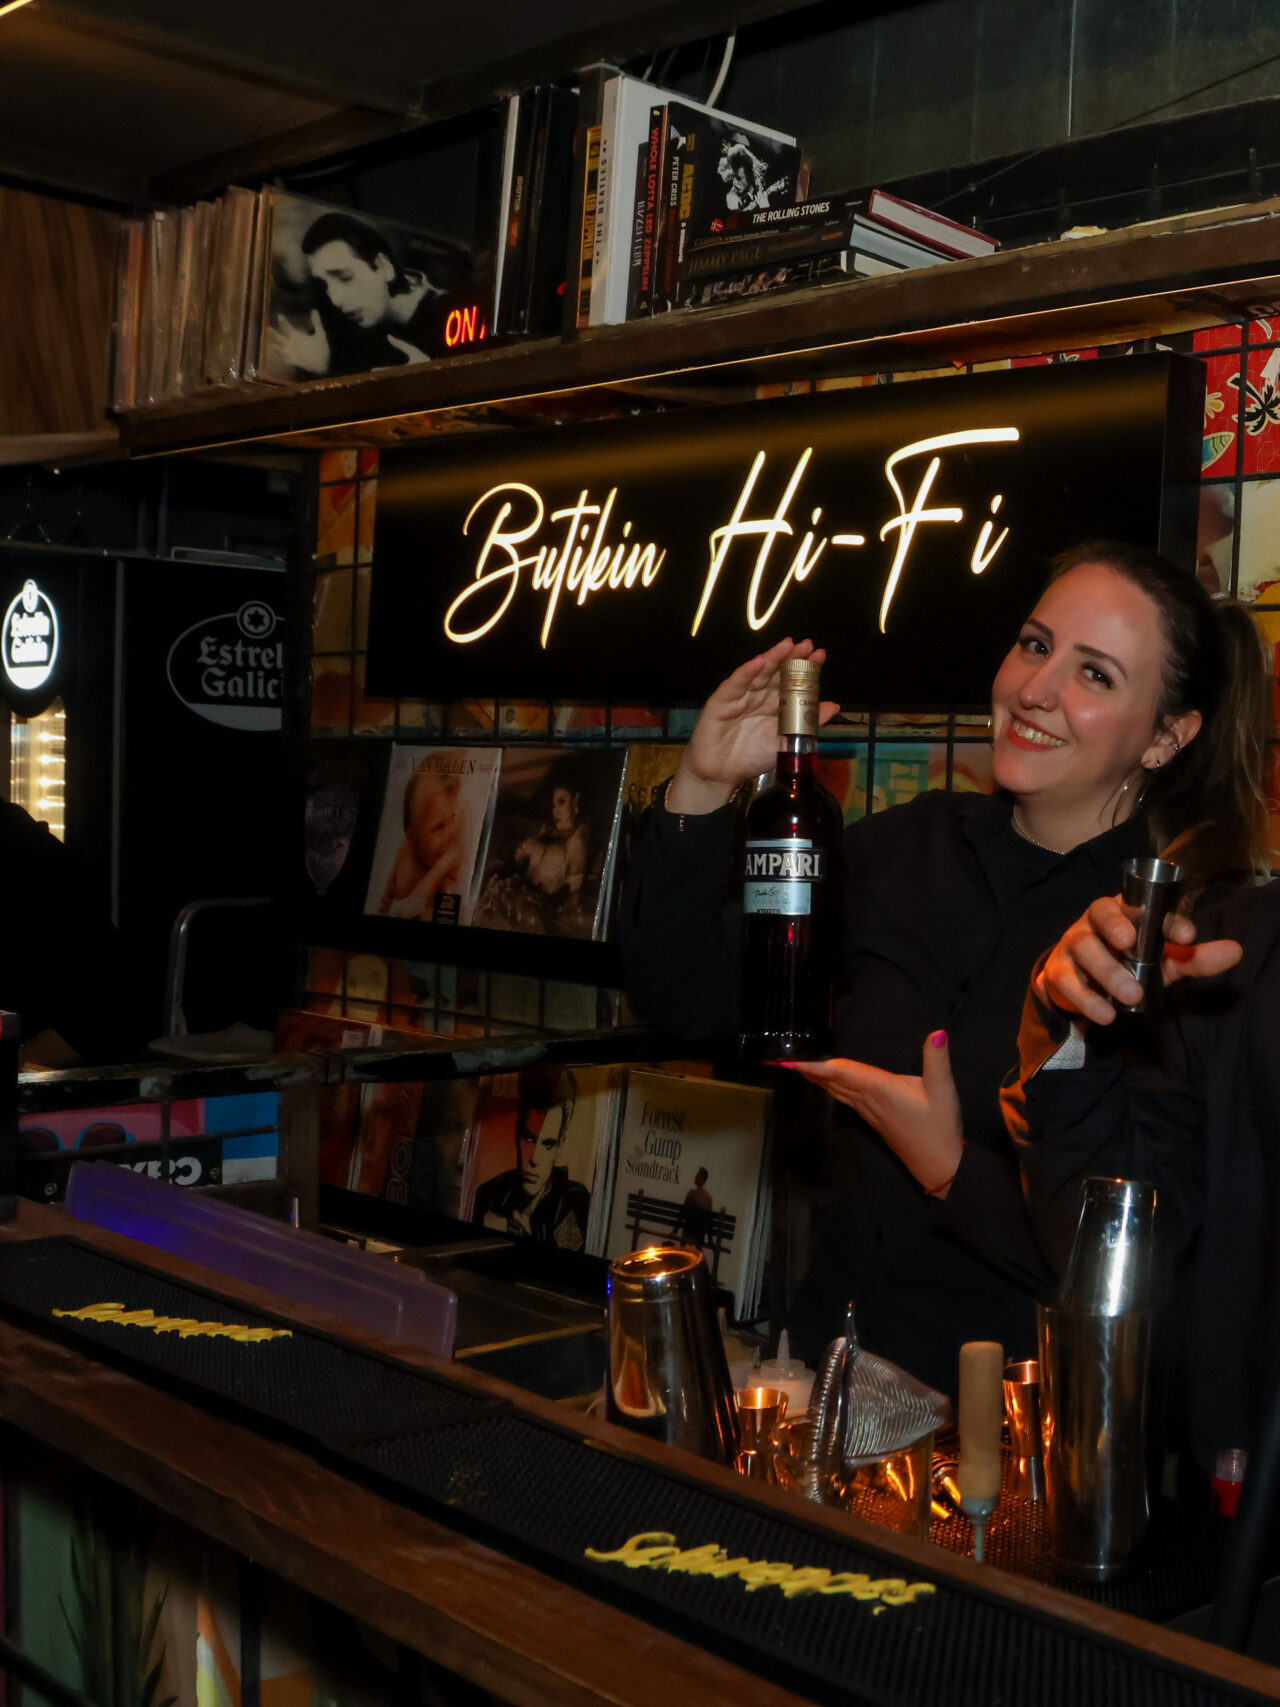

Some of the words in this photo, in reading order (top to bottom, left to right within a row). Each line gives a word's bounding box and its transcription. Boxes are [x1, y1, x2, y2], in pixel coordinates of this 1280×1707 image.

[649, 127, 660, 173] WHOLE
[597, 158, 608, 214] BEATLES
[671, 156, 680, 184] PETER
[646, 175, 657, 211] LOTTA
[669, 184, 678, 207] CRISS
[644, 213, 653, 234] LED
[752, 212, 768, 224] THE
[767, 206, 801, 221] ROLLING
[800, 202, 831, 216] STONES
[595, 223, 604, 244] THE
[640, 237, 653, 291] ZEPPELIN
[445, 305, 478, 347] ON
[443, 482, 666, 650] Butikin
[692, 426, 1020, 638] Hi-Fi
[641, 1101, 684, 1132] Forrest
[644, 1129, 682, 1165] Gump
[626, 1158, 680, 1185] Soundtrack
